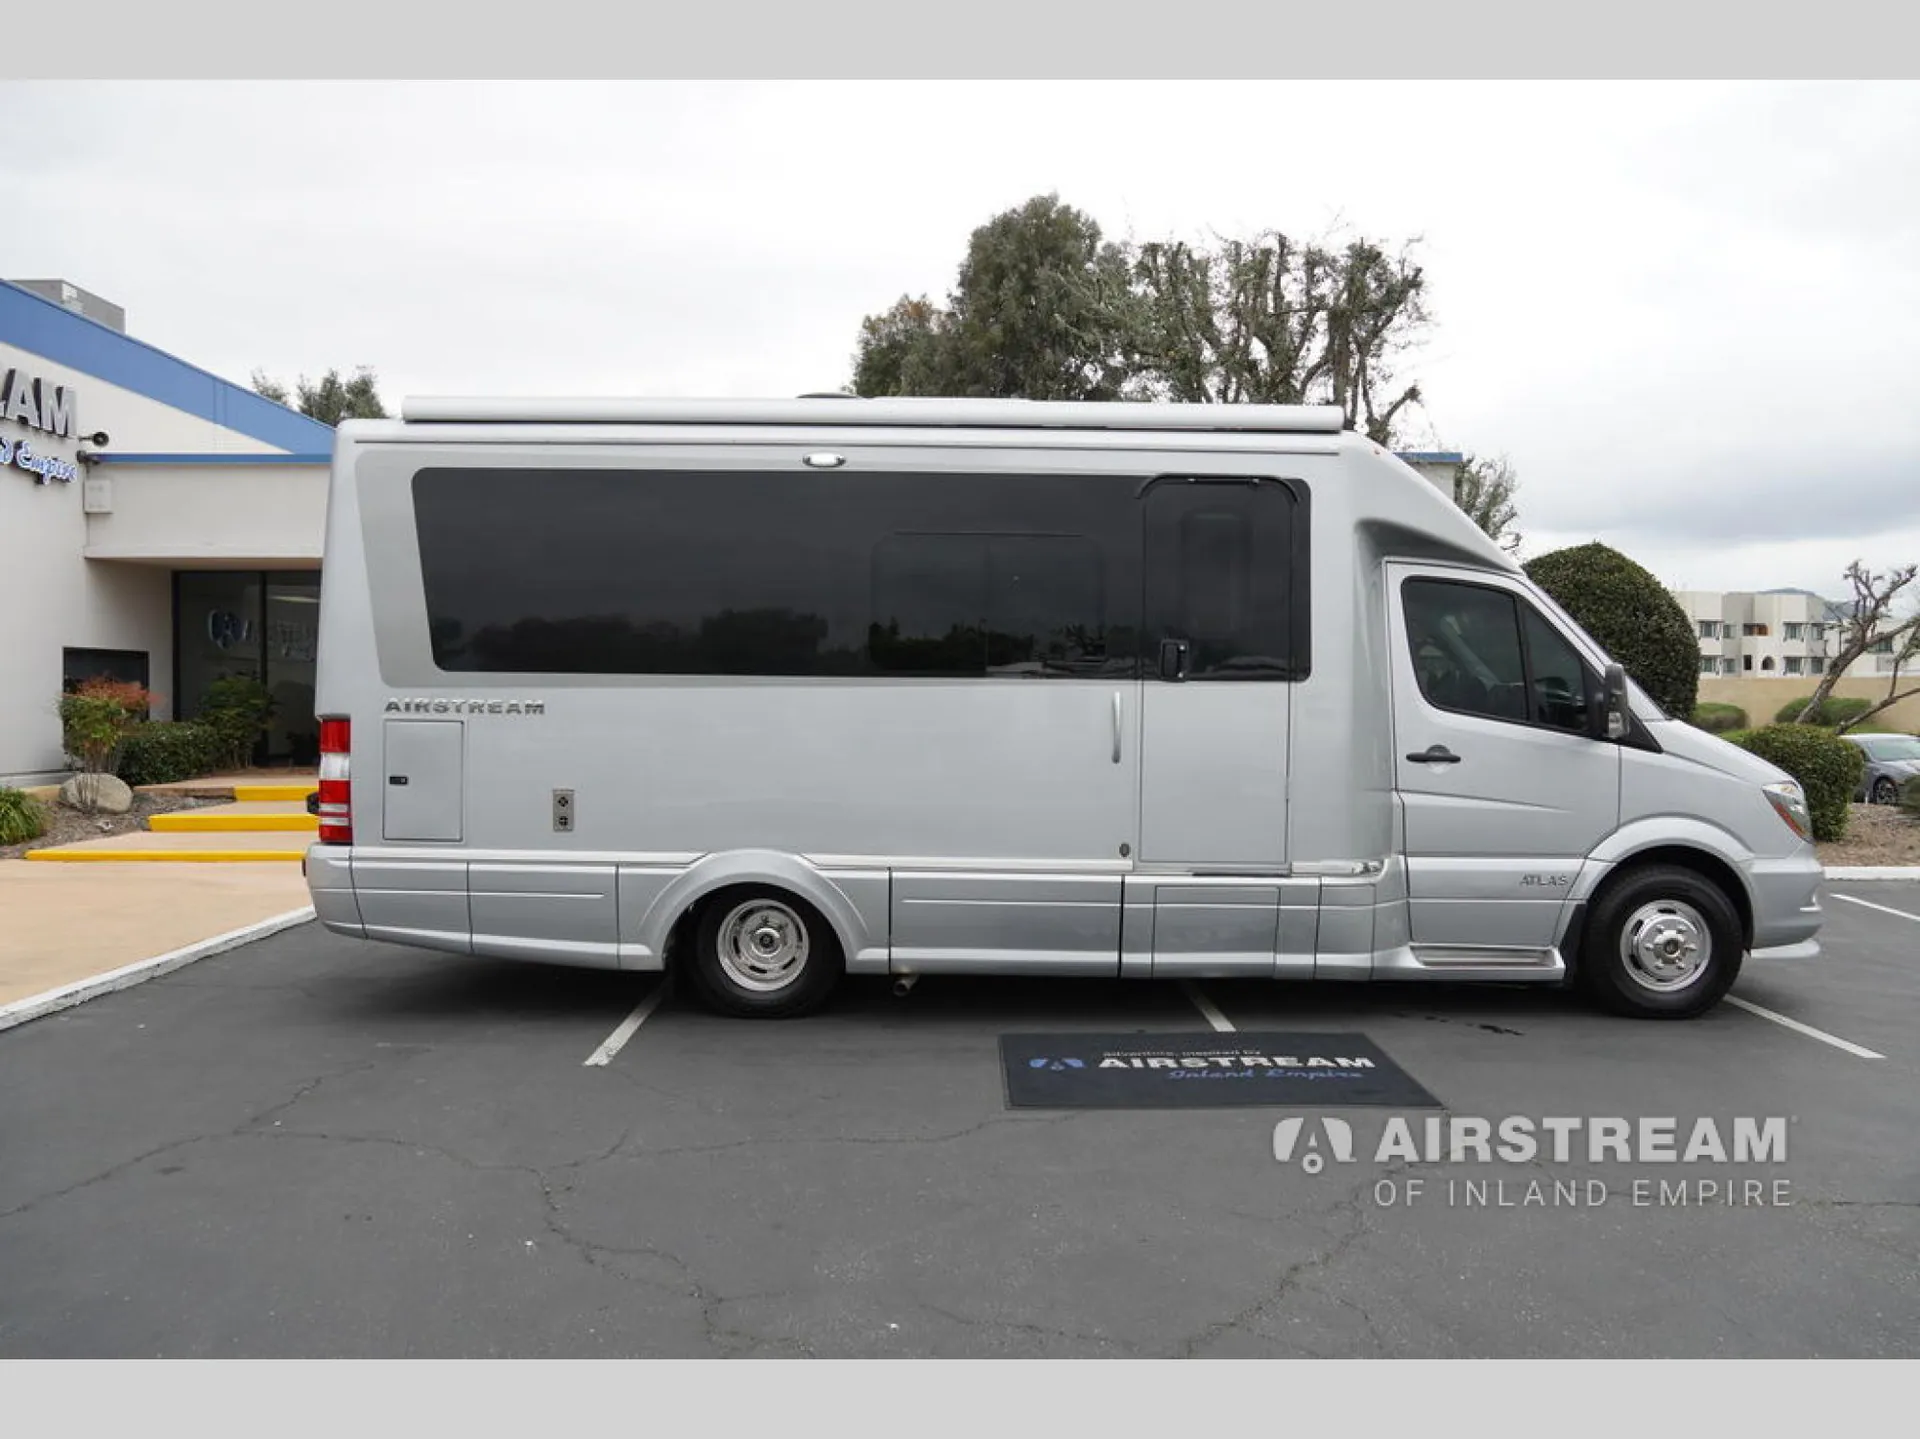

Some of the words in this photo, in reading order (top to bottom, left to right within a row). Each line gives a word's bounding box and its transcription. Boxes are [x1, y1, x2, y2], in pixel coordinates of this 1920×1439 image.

[384, 698, 545, 715] AIRSTREAM
[1520, 873, 1568, 886] ATLAS
[1099, 1057, 1375, 1068] AIRSTREAM
[1266, 1068, 1363, 1080] Empire
